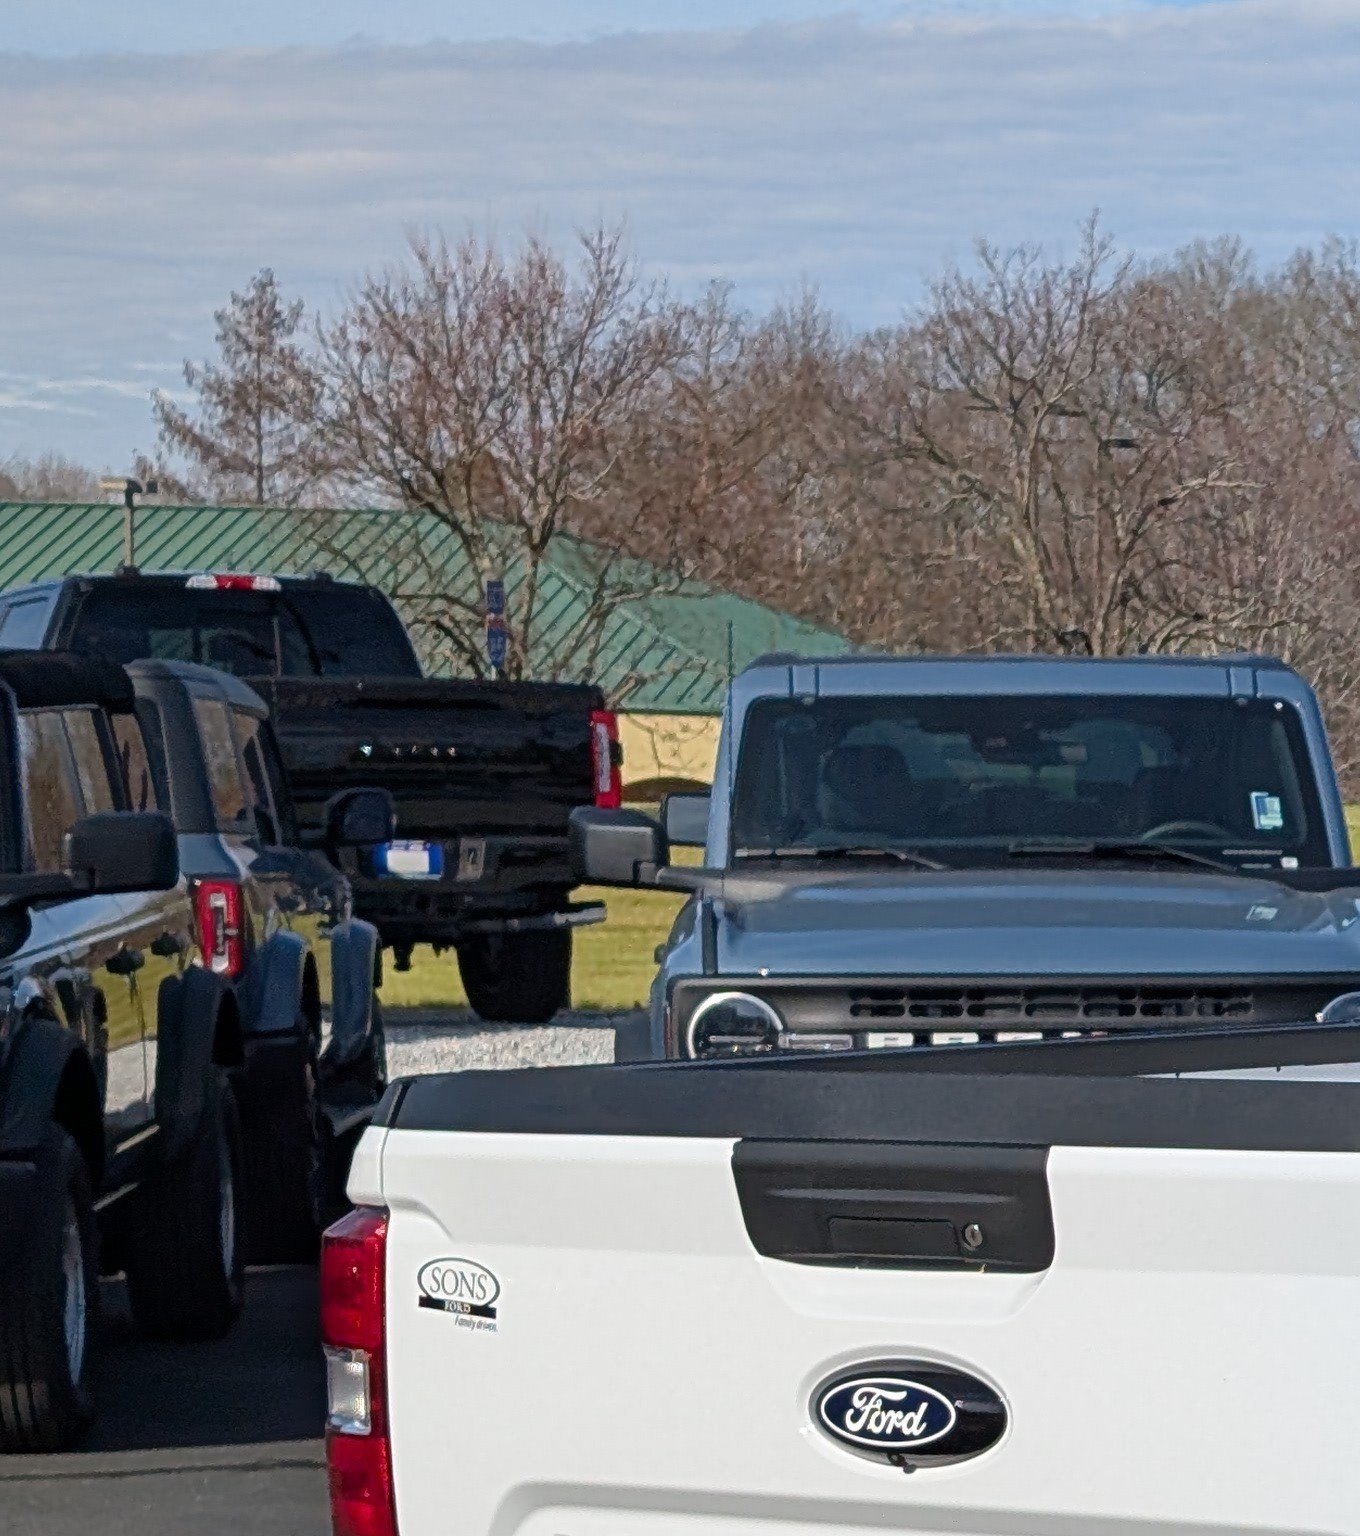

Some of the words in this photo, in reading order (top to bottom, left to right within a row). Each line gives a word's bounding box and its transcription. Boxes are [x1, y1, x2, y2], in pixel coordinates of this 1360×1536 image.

[430, 1266, 487, 1300] SONS
[444, 1300, 471, 1313] FORD
[845, 1386, 928, 1437] Ford
